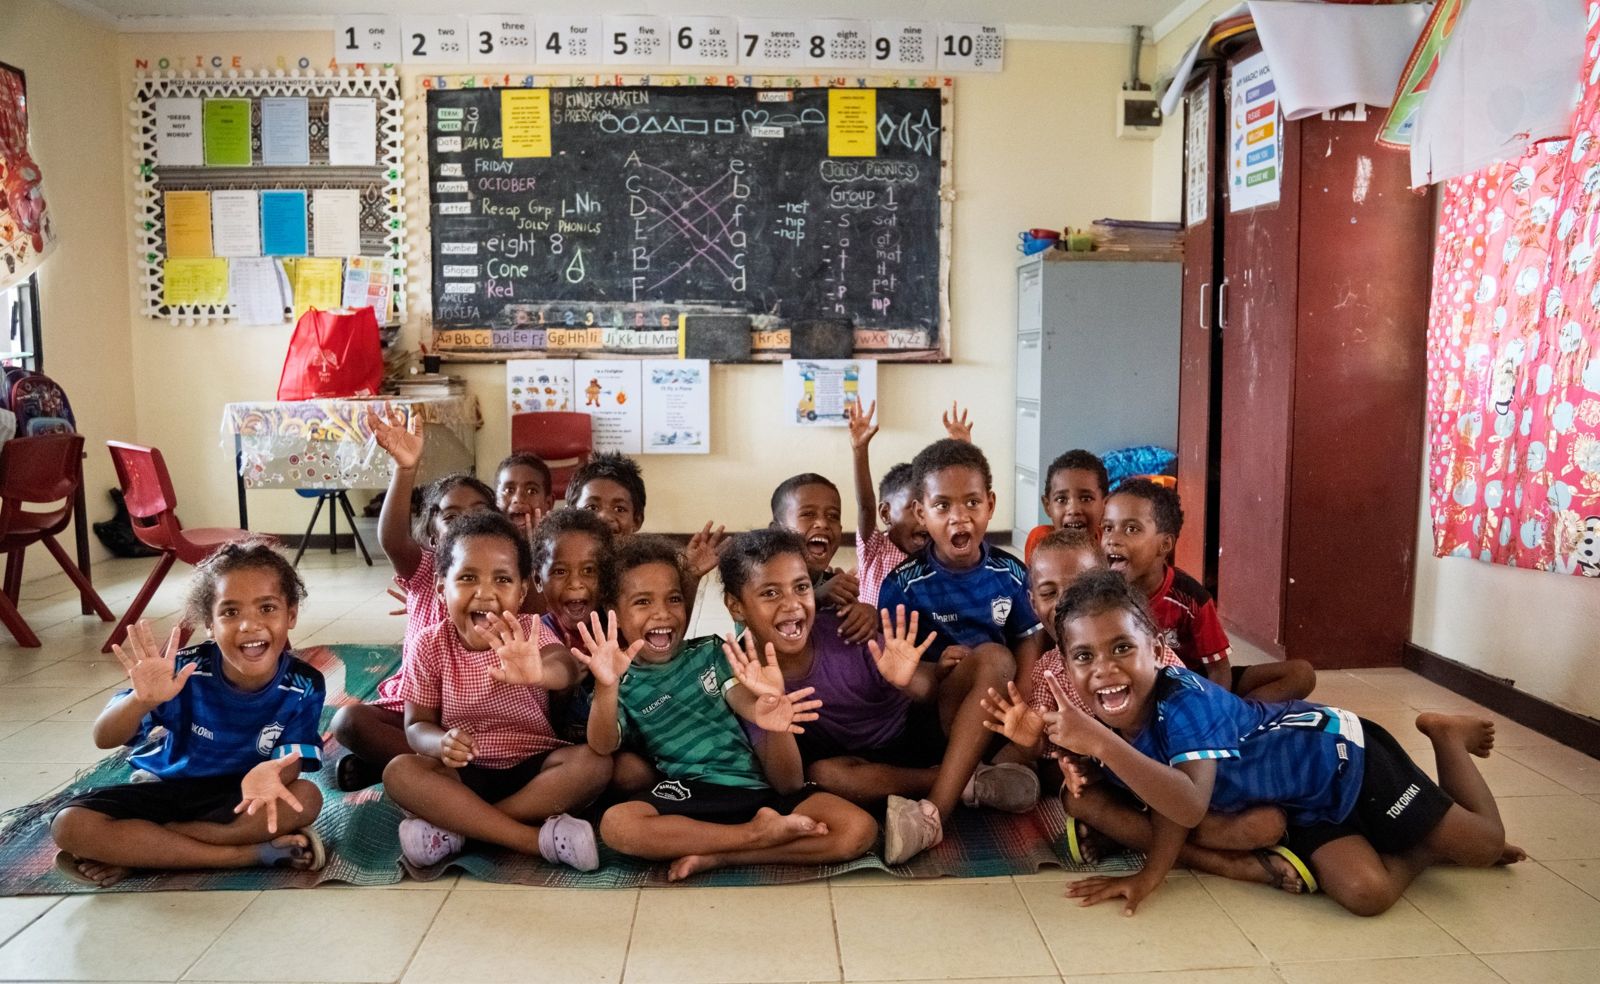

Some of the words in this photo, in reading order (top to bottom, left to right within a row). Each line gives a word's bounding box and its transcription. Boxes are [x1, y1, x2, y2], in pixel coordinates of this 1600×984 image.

[368, 27, 385, 35] one
[438, 28, 455, 36] two
[501, 22, 525, 31] three
[570, 25, 588, 34] four
[639, 26, 655, 36] five
[709, 27, 721, 35] six
[770, 31, 795, 39] seven
[836, 30, 858, 41] eight
[903, 26, 922, 34] nine
[982, 25, 996, 34] ten
[345, 27, 359, 49] 1
[412, 33, 427, 56] 2
[479, 31, 493, 54] 3
[546, 32, 562, 55] 4
[613, 33, 628, 55] 5
[677, 27, 693, 49] 6
[743, 34, 759, 58] 7
[809, 36, 825, 58] 8
[943, 35, 973, 57] 10
[875, 38, 891, 60] 9
[467, 106, 480, 121] 3
[474, 158, 514, 174] FRIDAY
[623, 150, 642, 168] A
[729, 159, 745, 174] e
[478, 177, 536, 193] OCTOBER
[626, 176, 641, 193] C
[733, 175, 750, 199] b
[831, 185, 875, 206] Group
[884, 186, 898, 206] 1
[482, 197, 520, 222] Recap
[630, 195, 648, 217] D
[734, 204, 747, 227] f
[517, 217, 550, 230] JOLLY
[558, 219, 602, 234] PHONICS
[634, 216, 648, 241] E
[486, 232, 536, 258] eight
[550, 233, 563, 254] 8
[730, 231, 747, 248] a
[487, 258, 529, 279] Cone
[632, 247, 650, 271] B
[486, 279, 514, 299] Red
[632, 276, 646, 302] F
[731, 268, 746, 292] d
[564, 311, 576, 325] 2
[585, 312, 594, 326] 3
[436, 333, 452, 344] Aa
[454, 333, 471, 345] Bb
[513, 331, 528, 343] Ee
[548, 332, 565, 346] Gg
[568, 332, 585, 344] Hh
[618, 332, 633, 345] Kk
[775, 333, 790, 344] Ss
[1386, 783, 1421, 819] TOKORIKI
